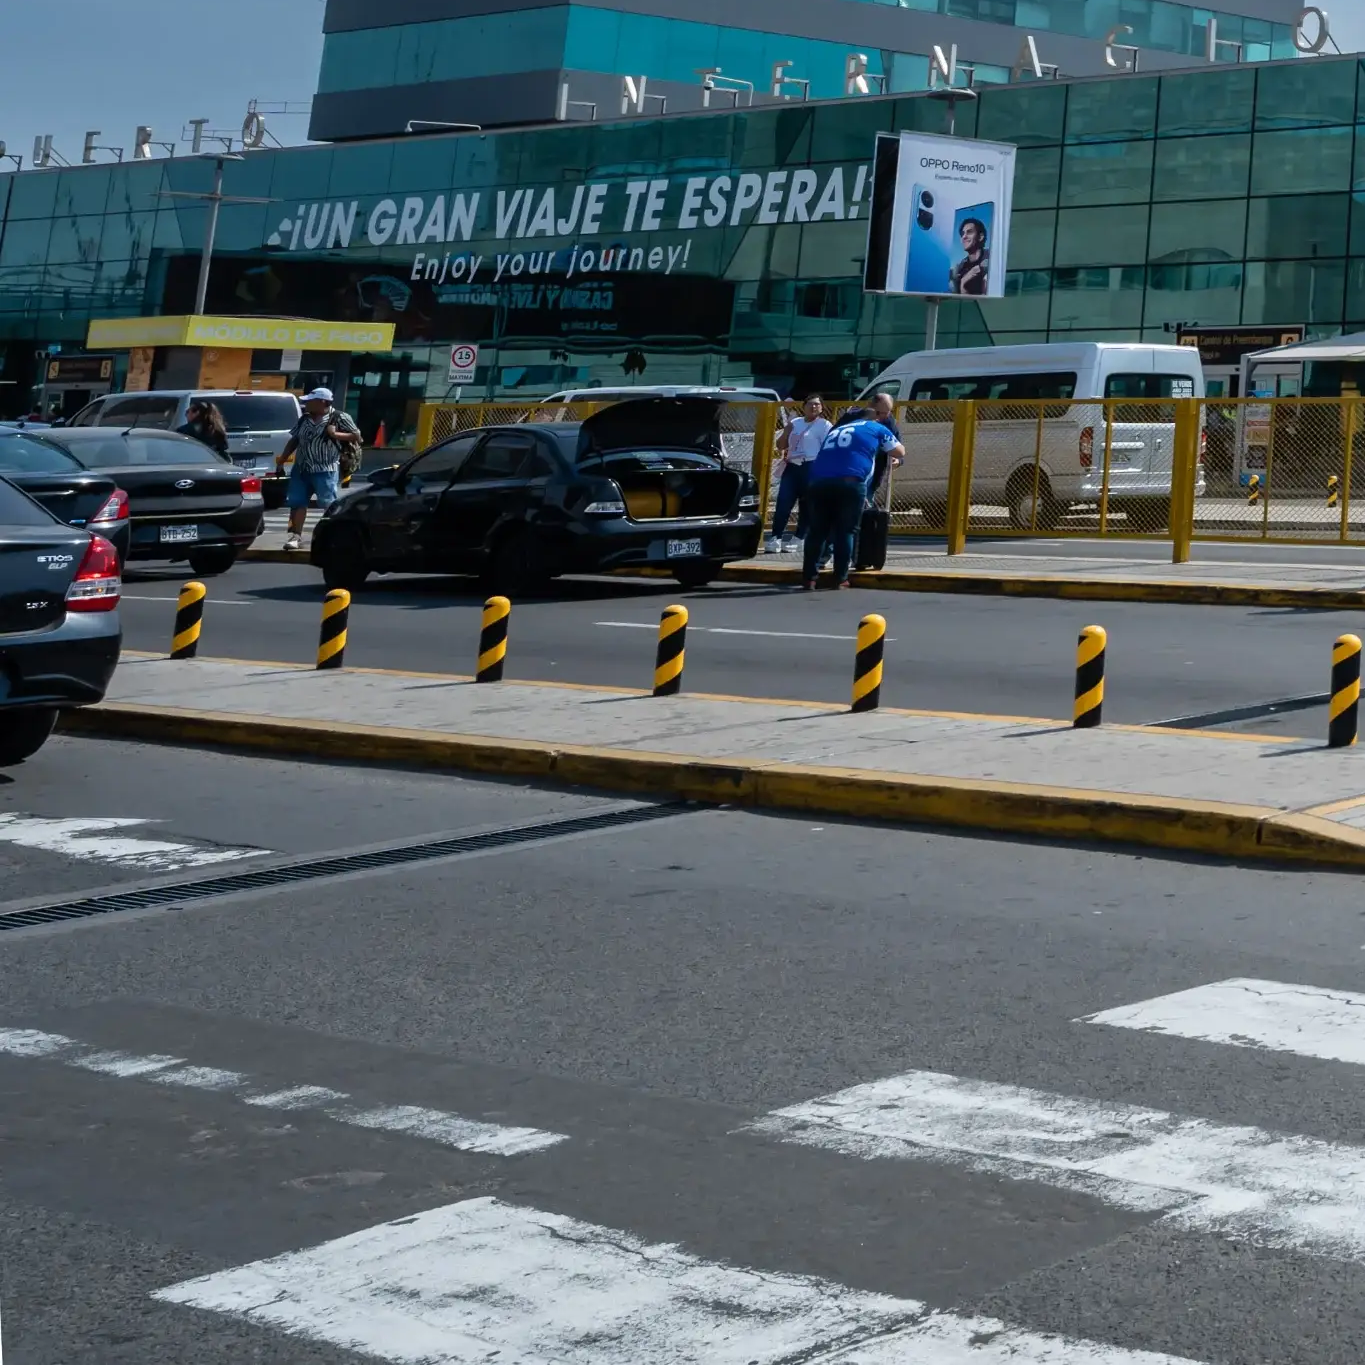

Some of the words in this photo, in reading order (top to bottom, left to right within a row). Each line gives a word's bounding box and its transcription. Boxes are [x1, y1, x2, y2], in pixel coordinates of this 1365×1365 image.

[920, 157, 949, 170] OPPO
[951, 160, 986, 174] Reno10
[367, 192, 481, 246] GRAN
[495, 183, 608, 239] VIAJE
[622, 178, 669, 233] TE
[678, 165, 868, 230] ESPERA!
[410, 251, 484, 285] Enjoy
[493, 250, 557, 283] your
[565, 239, 693, 280] journey!
[194, 322, 290, 342] MÓDULO
[294, 328, 324, 344] DE
[458, 350, 471, 360] 15
[823, 426, 856, 450] 26
[37, 554, 73, 563] ETIOS
[48, 562, 68, 570] GLP
